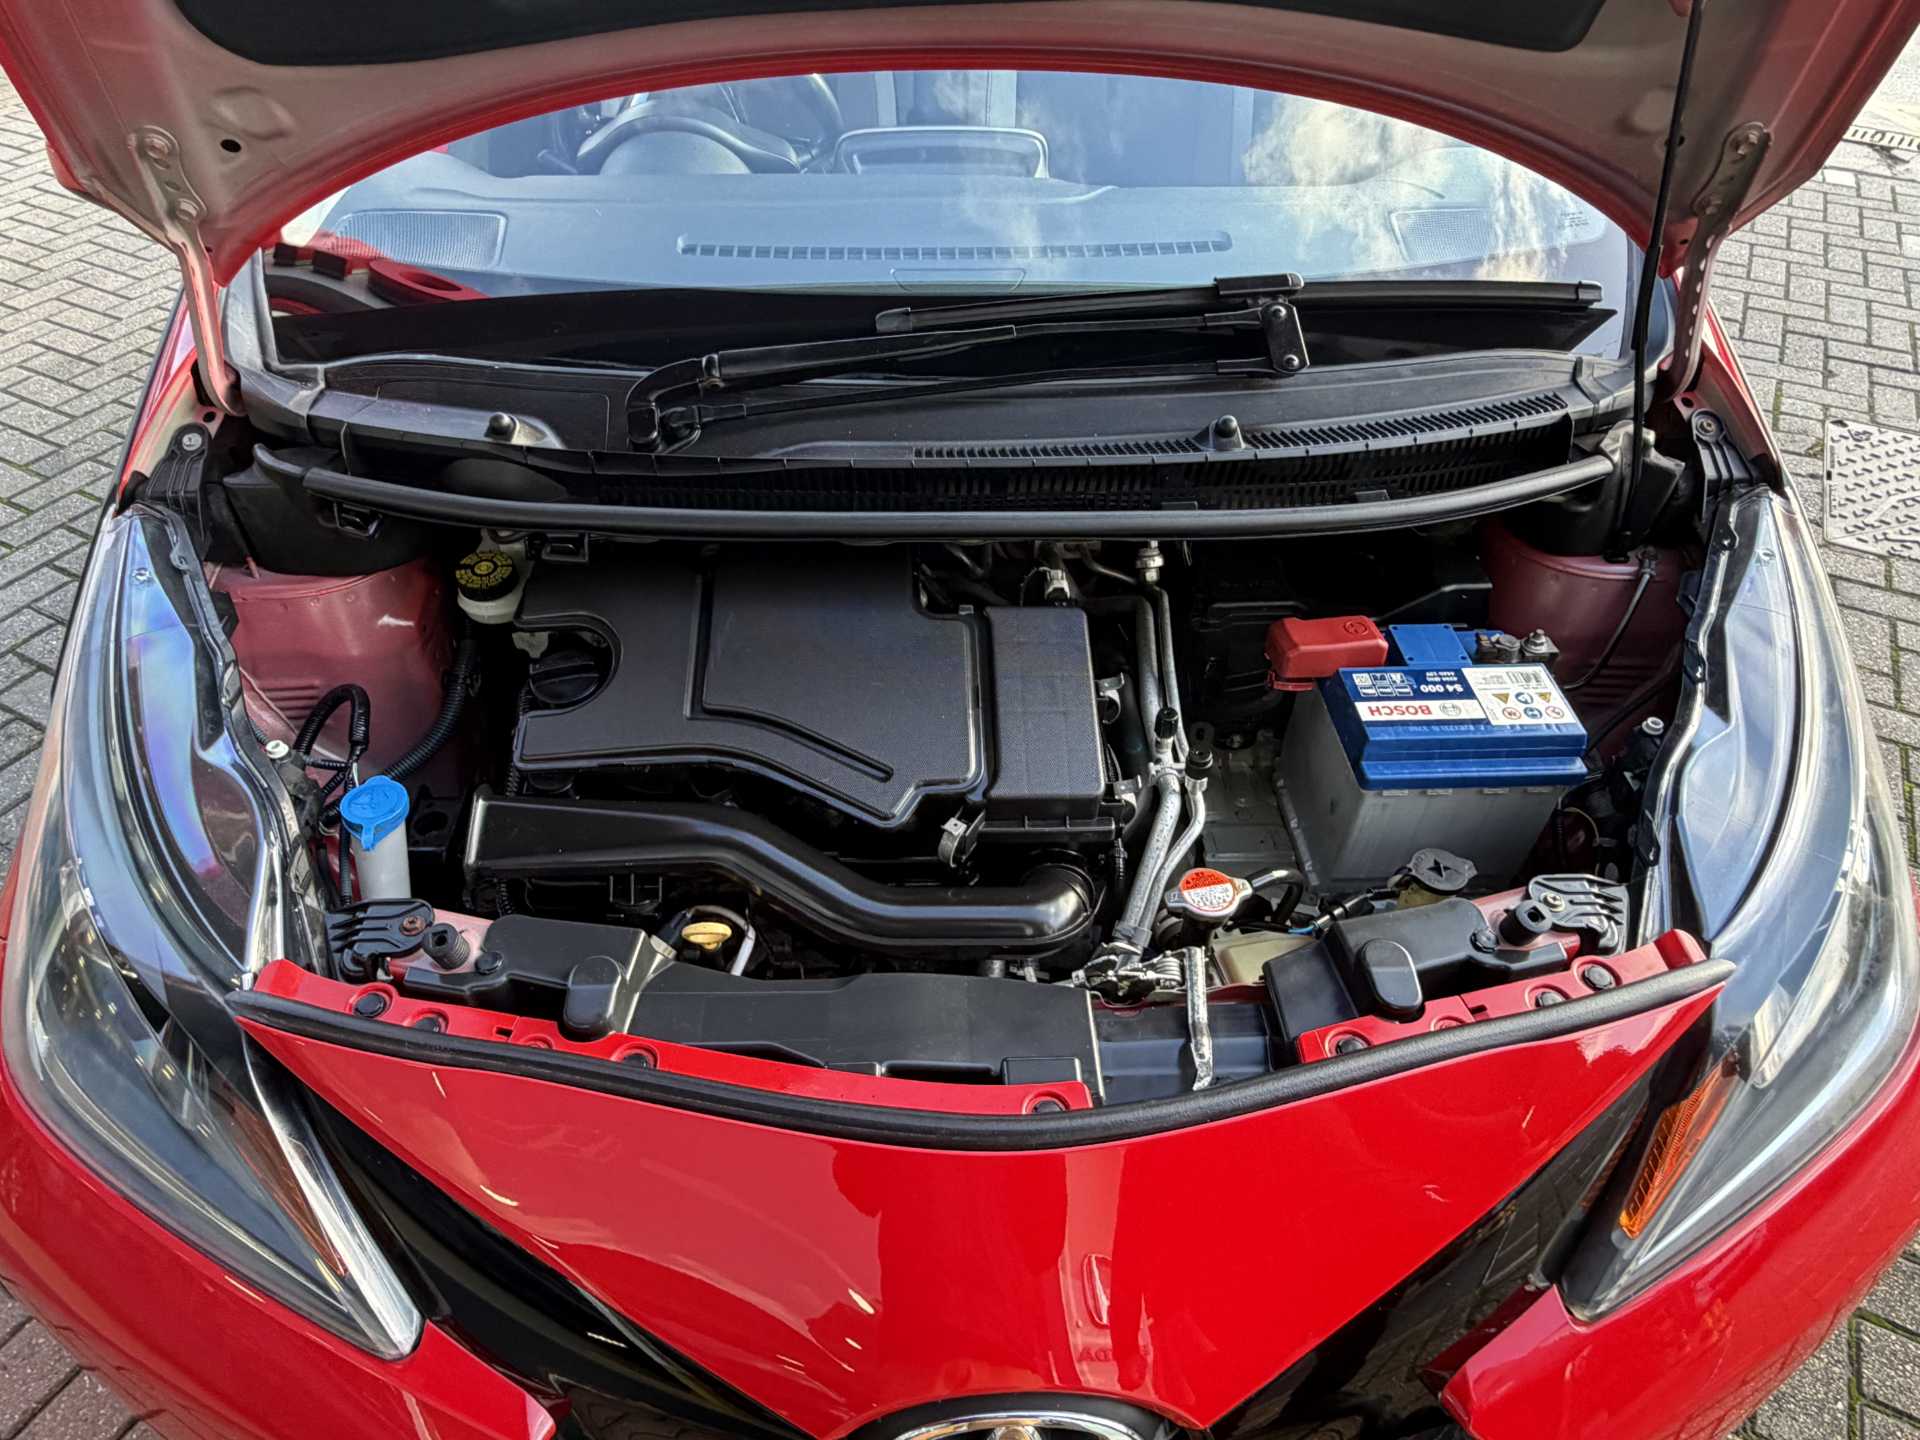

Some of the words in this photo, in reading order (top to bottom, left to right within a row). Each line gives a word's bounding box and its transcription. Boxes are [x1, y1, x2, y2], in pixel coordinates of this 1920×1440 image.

[1420, 684, 1444, 693] 000
[1445, 684, 1464, 693] S4
[1368, 704, 1433, 717] BOSCH
